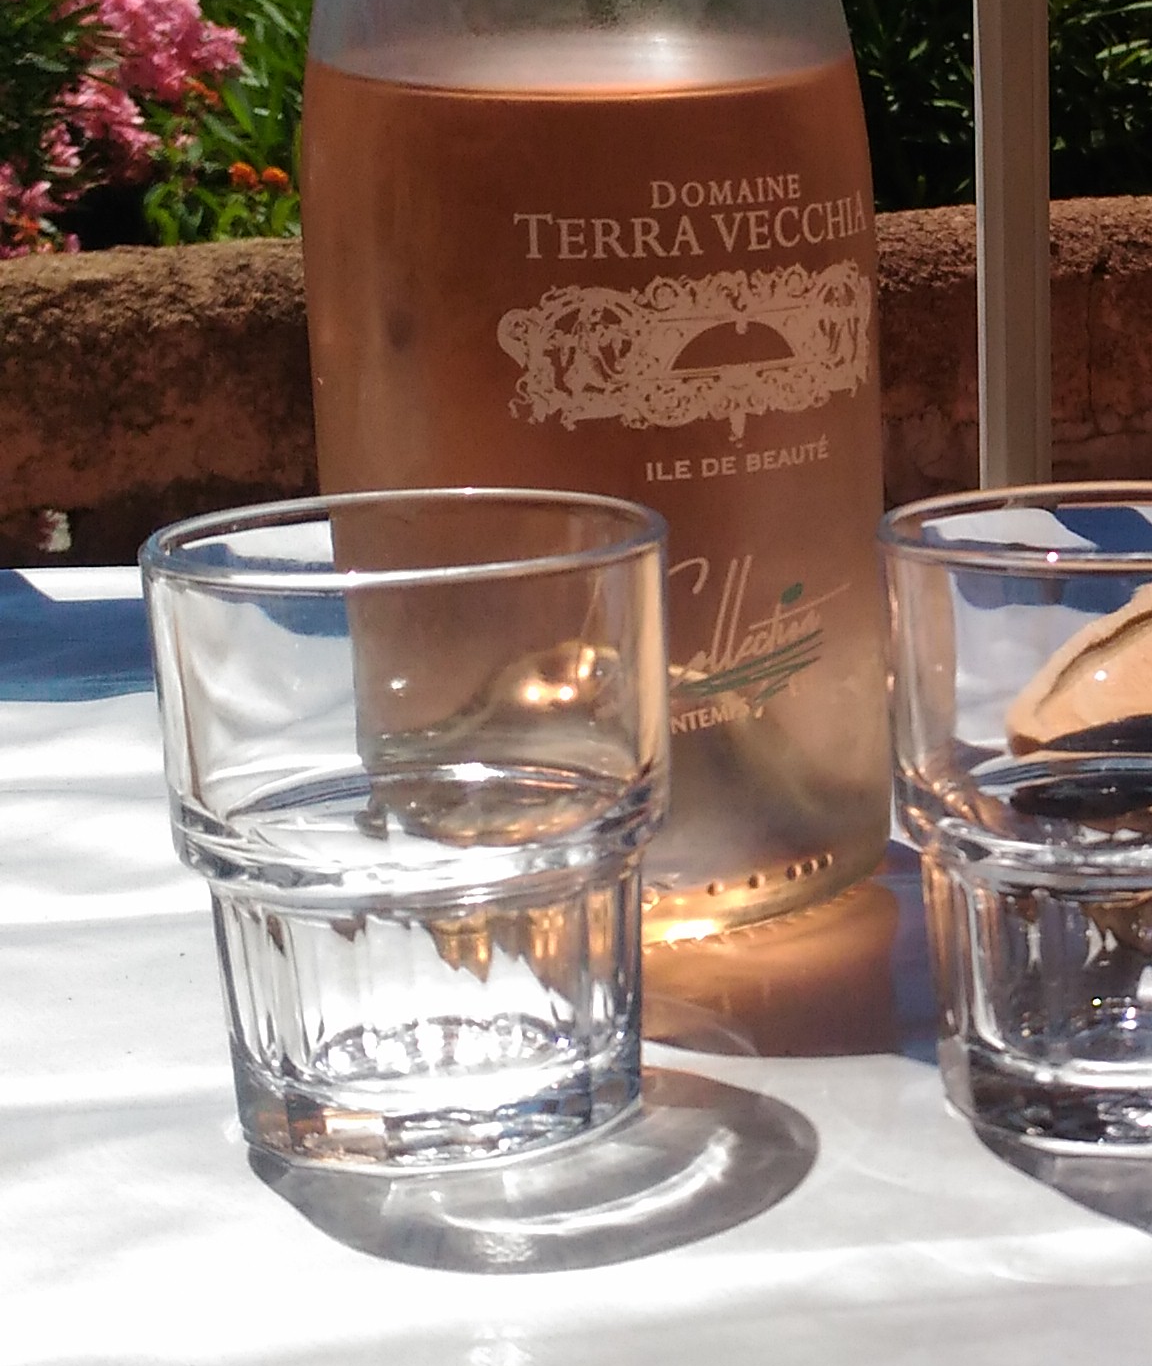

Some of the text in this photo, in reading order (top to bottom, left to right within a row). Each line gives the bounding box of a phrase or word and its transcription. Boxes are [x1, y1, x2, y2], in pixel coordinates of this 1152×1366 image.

[650, 174, 801, 210] DOMAINE
[513, 190, 868, 260] TERRA VECCHIA
[645, 434, 830, 482] ILE DE BEAUTÉ
